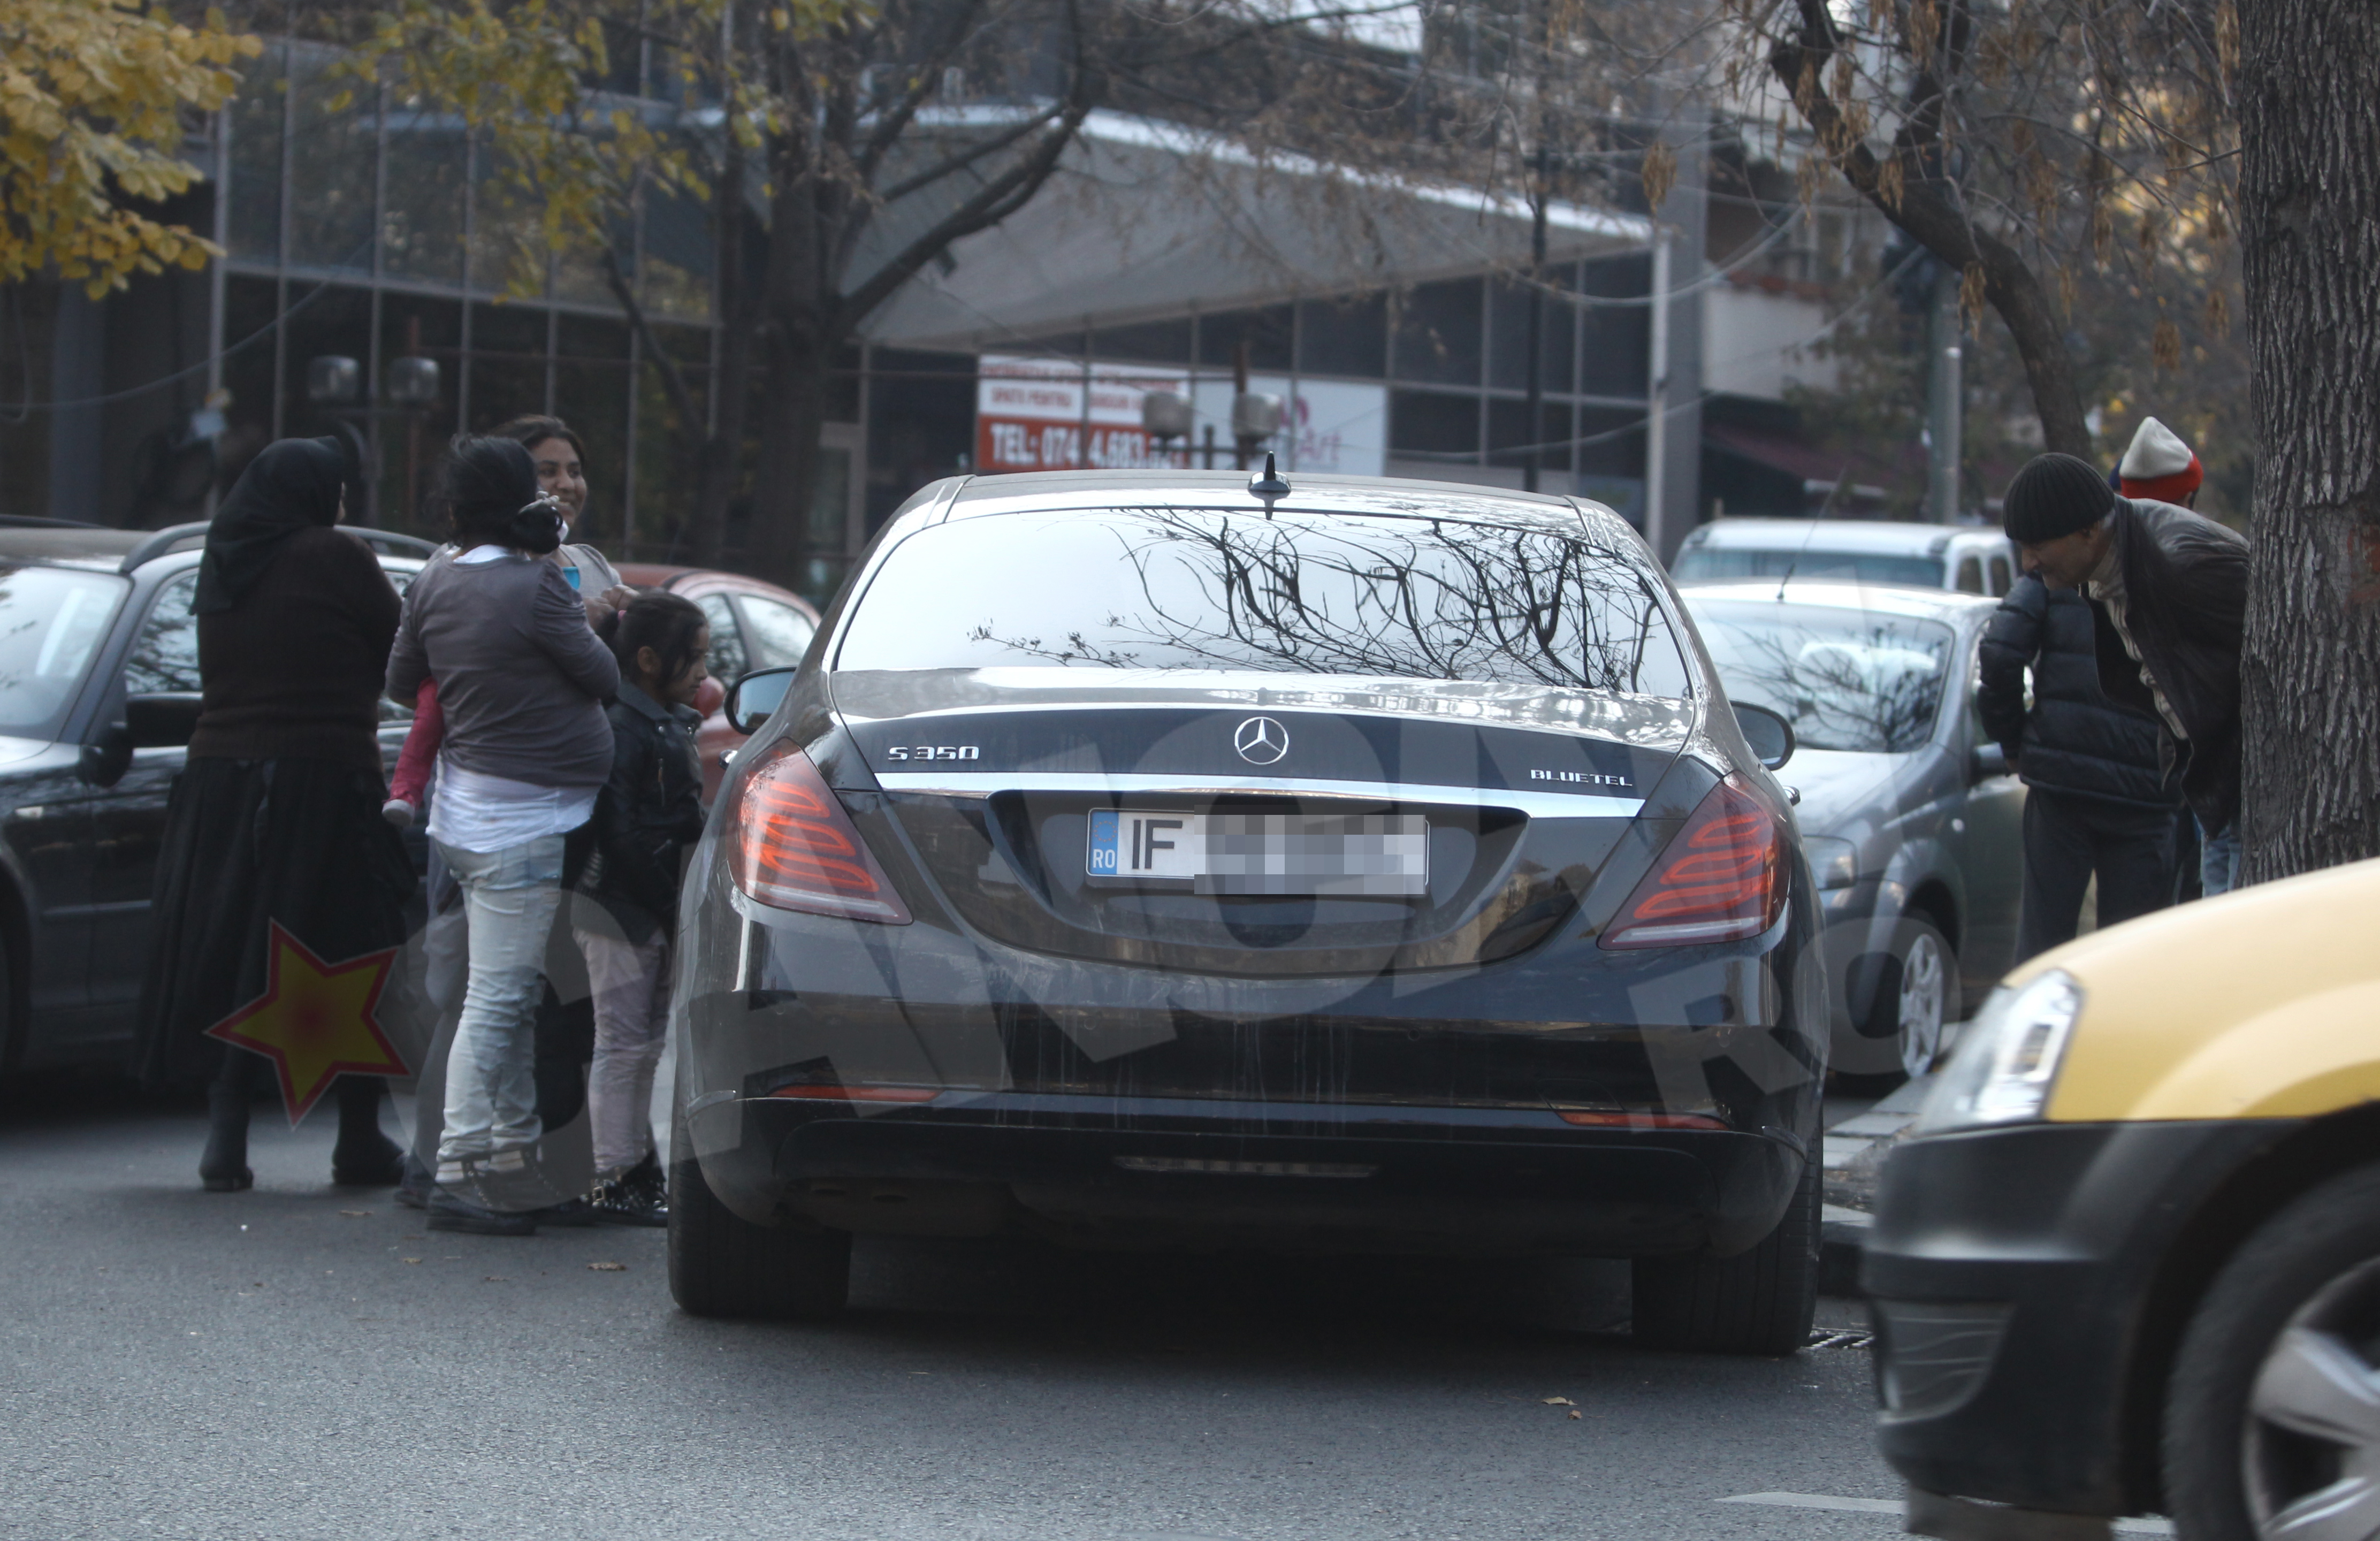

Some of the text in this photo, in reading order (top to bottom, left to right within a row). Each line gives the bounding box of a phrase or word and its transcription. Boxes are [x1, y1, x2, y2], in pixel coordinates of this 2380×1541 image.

[888, 746, 980, 761] S 350
[1092, 849, 1116, 868] RO
[1132, 819, 1183, 870] IF
